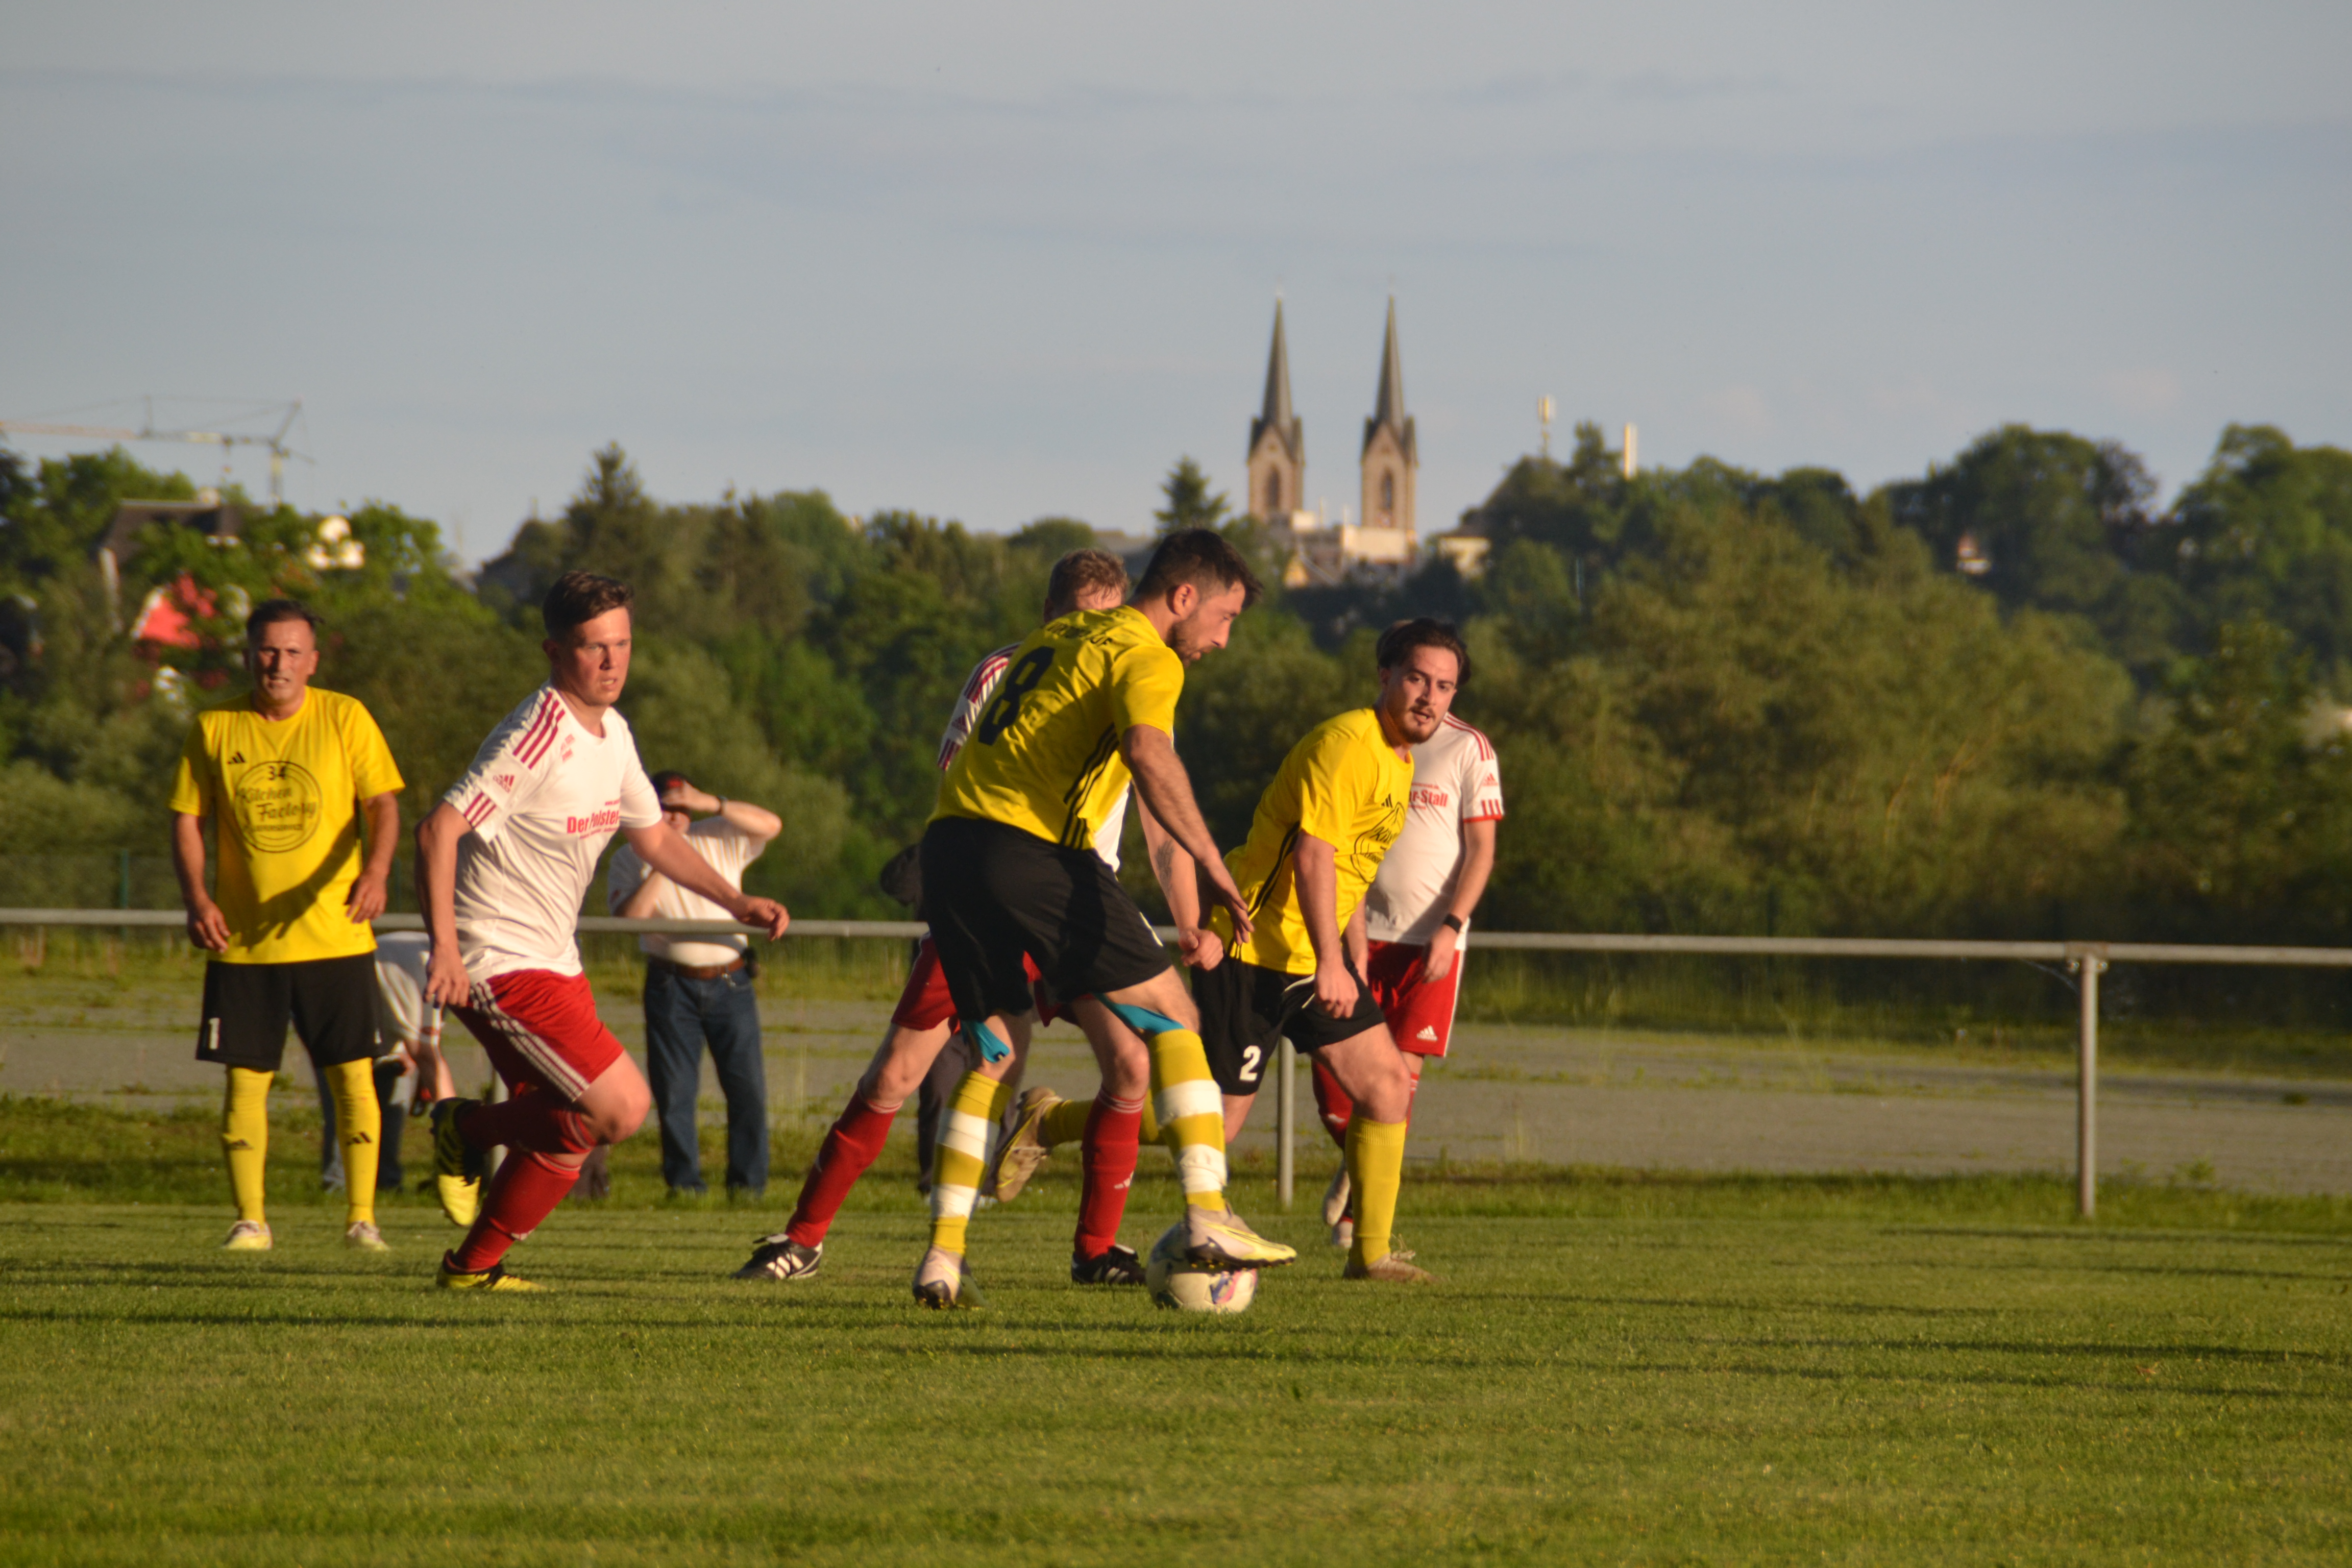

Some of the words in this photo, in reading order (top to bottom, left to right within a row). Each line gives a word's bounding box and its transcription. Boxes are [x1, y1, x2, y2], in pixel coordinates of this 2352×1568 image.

[978, 646, 1055, 746] 8
[268, 766, 286, 780] 34
[238, 787, 292, 803] Kitchen
[256, 801, 316, 822] Factory
[567, 816, 590, 833] Der
[208, 1017, 220, 1049] 1
[1239, 1045, 1261, 1081] 2
